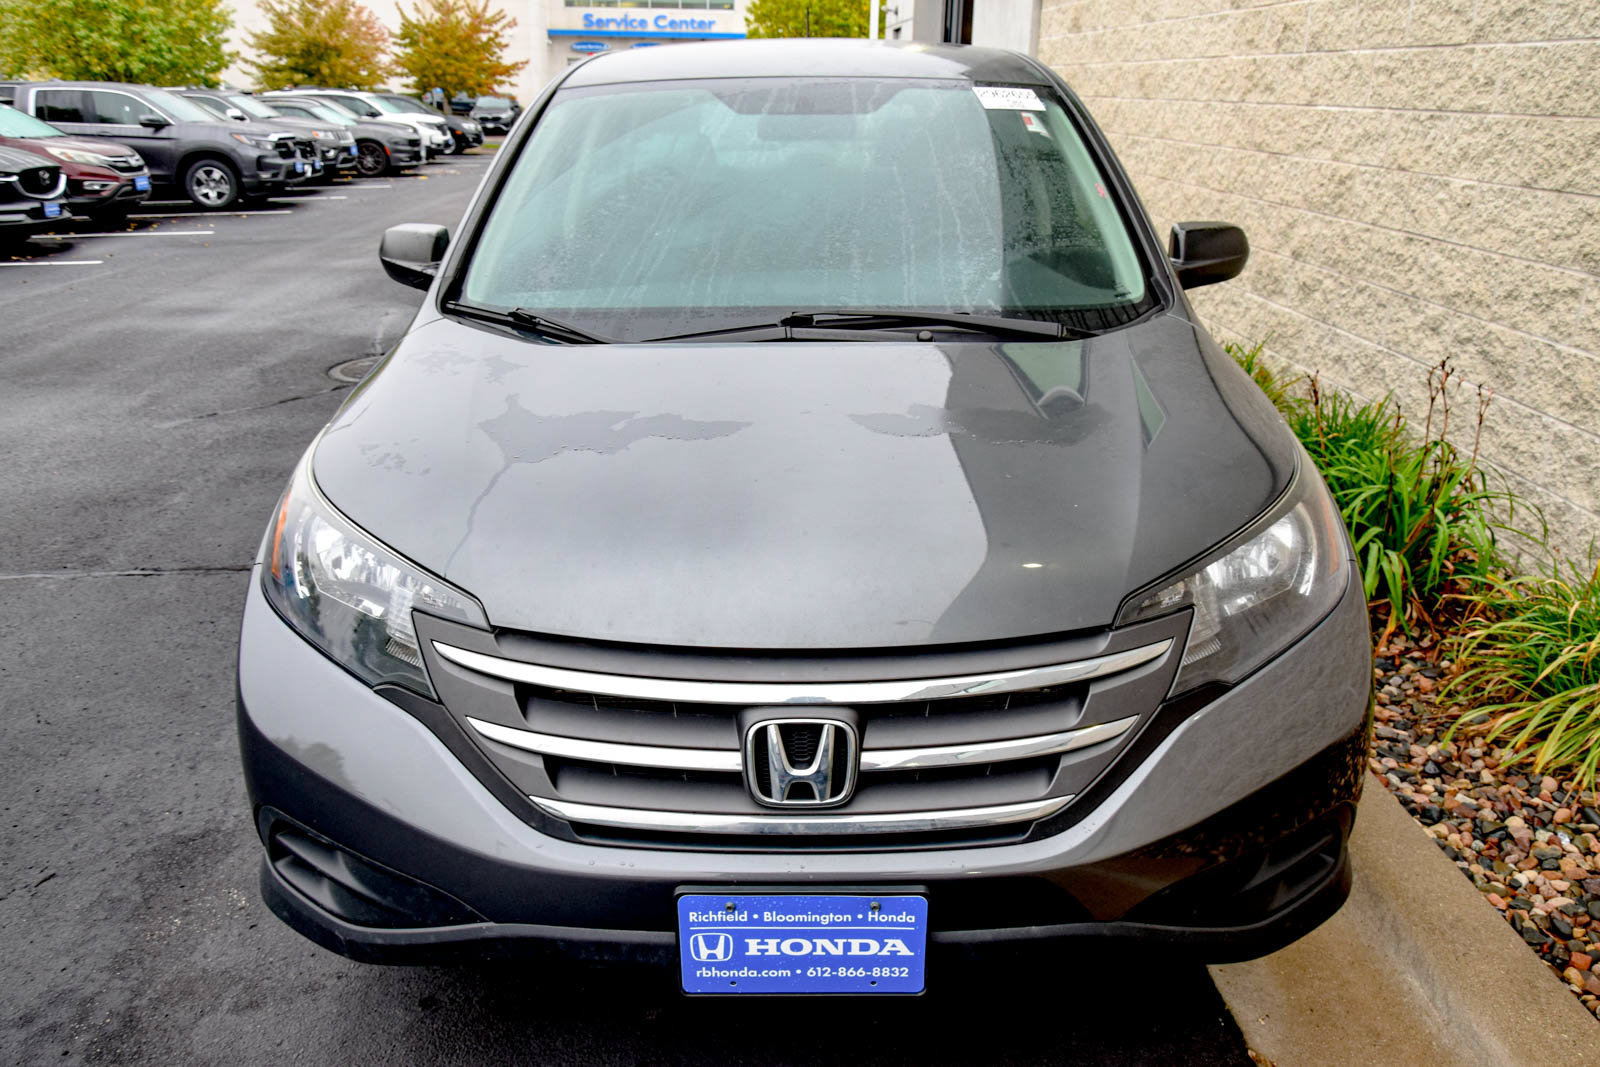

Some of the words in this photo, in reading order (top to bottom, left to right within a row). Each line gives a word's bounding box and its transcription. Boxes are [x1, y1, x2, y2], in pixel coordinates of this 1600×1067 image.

[583, 12, 648, 28] Service
[653, 15, 716, 30] Center
[689, 911, 748, 923] Richfield
[763, 911, 852, 925] Bloomington
[868, 911, 916, 923] Honda
[744, 938, 915, 956] HONDA
[696, 966, 791, 978] rbhonda.com
[806, 966, 909, 978] 612-866-8832
